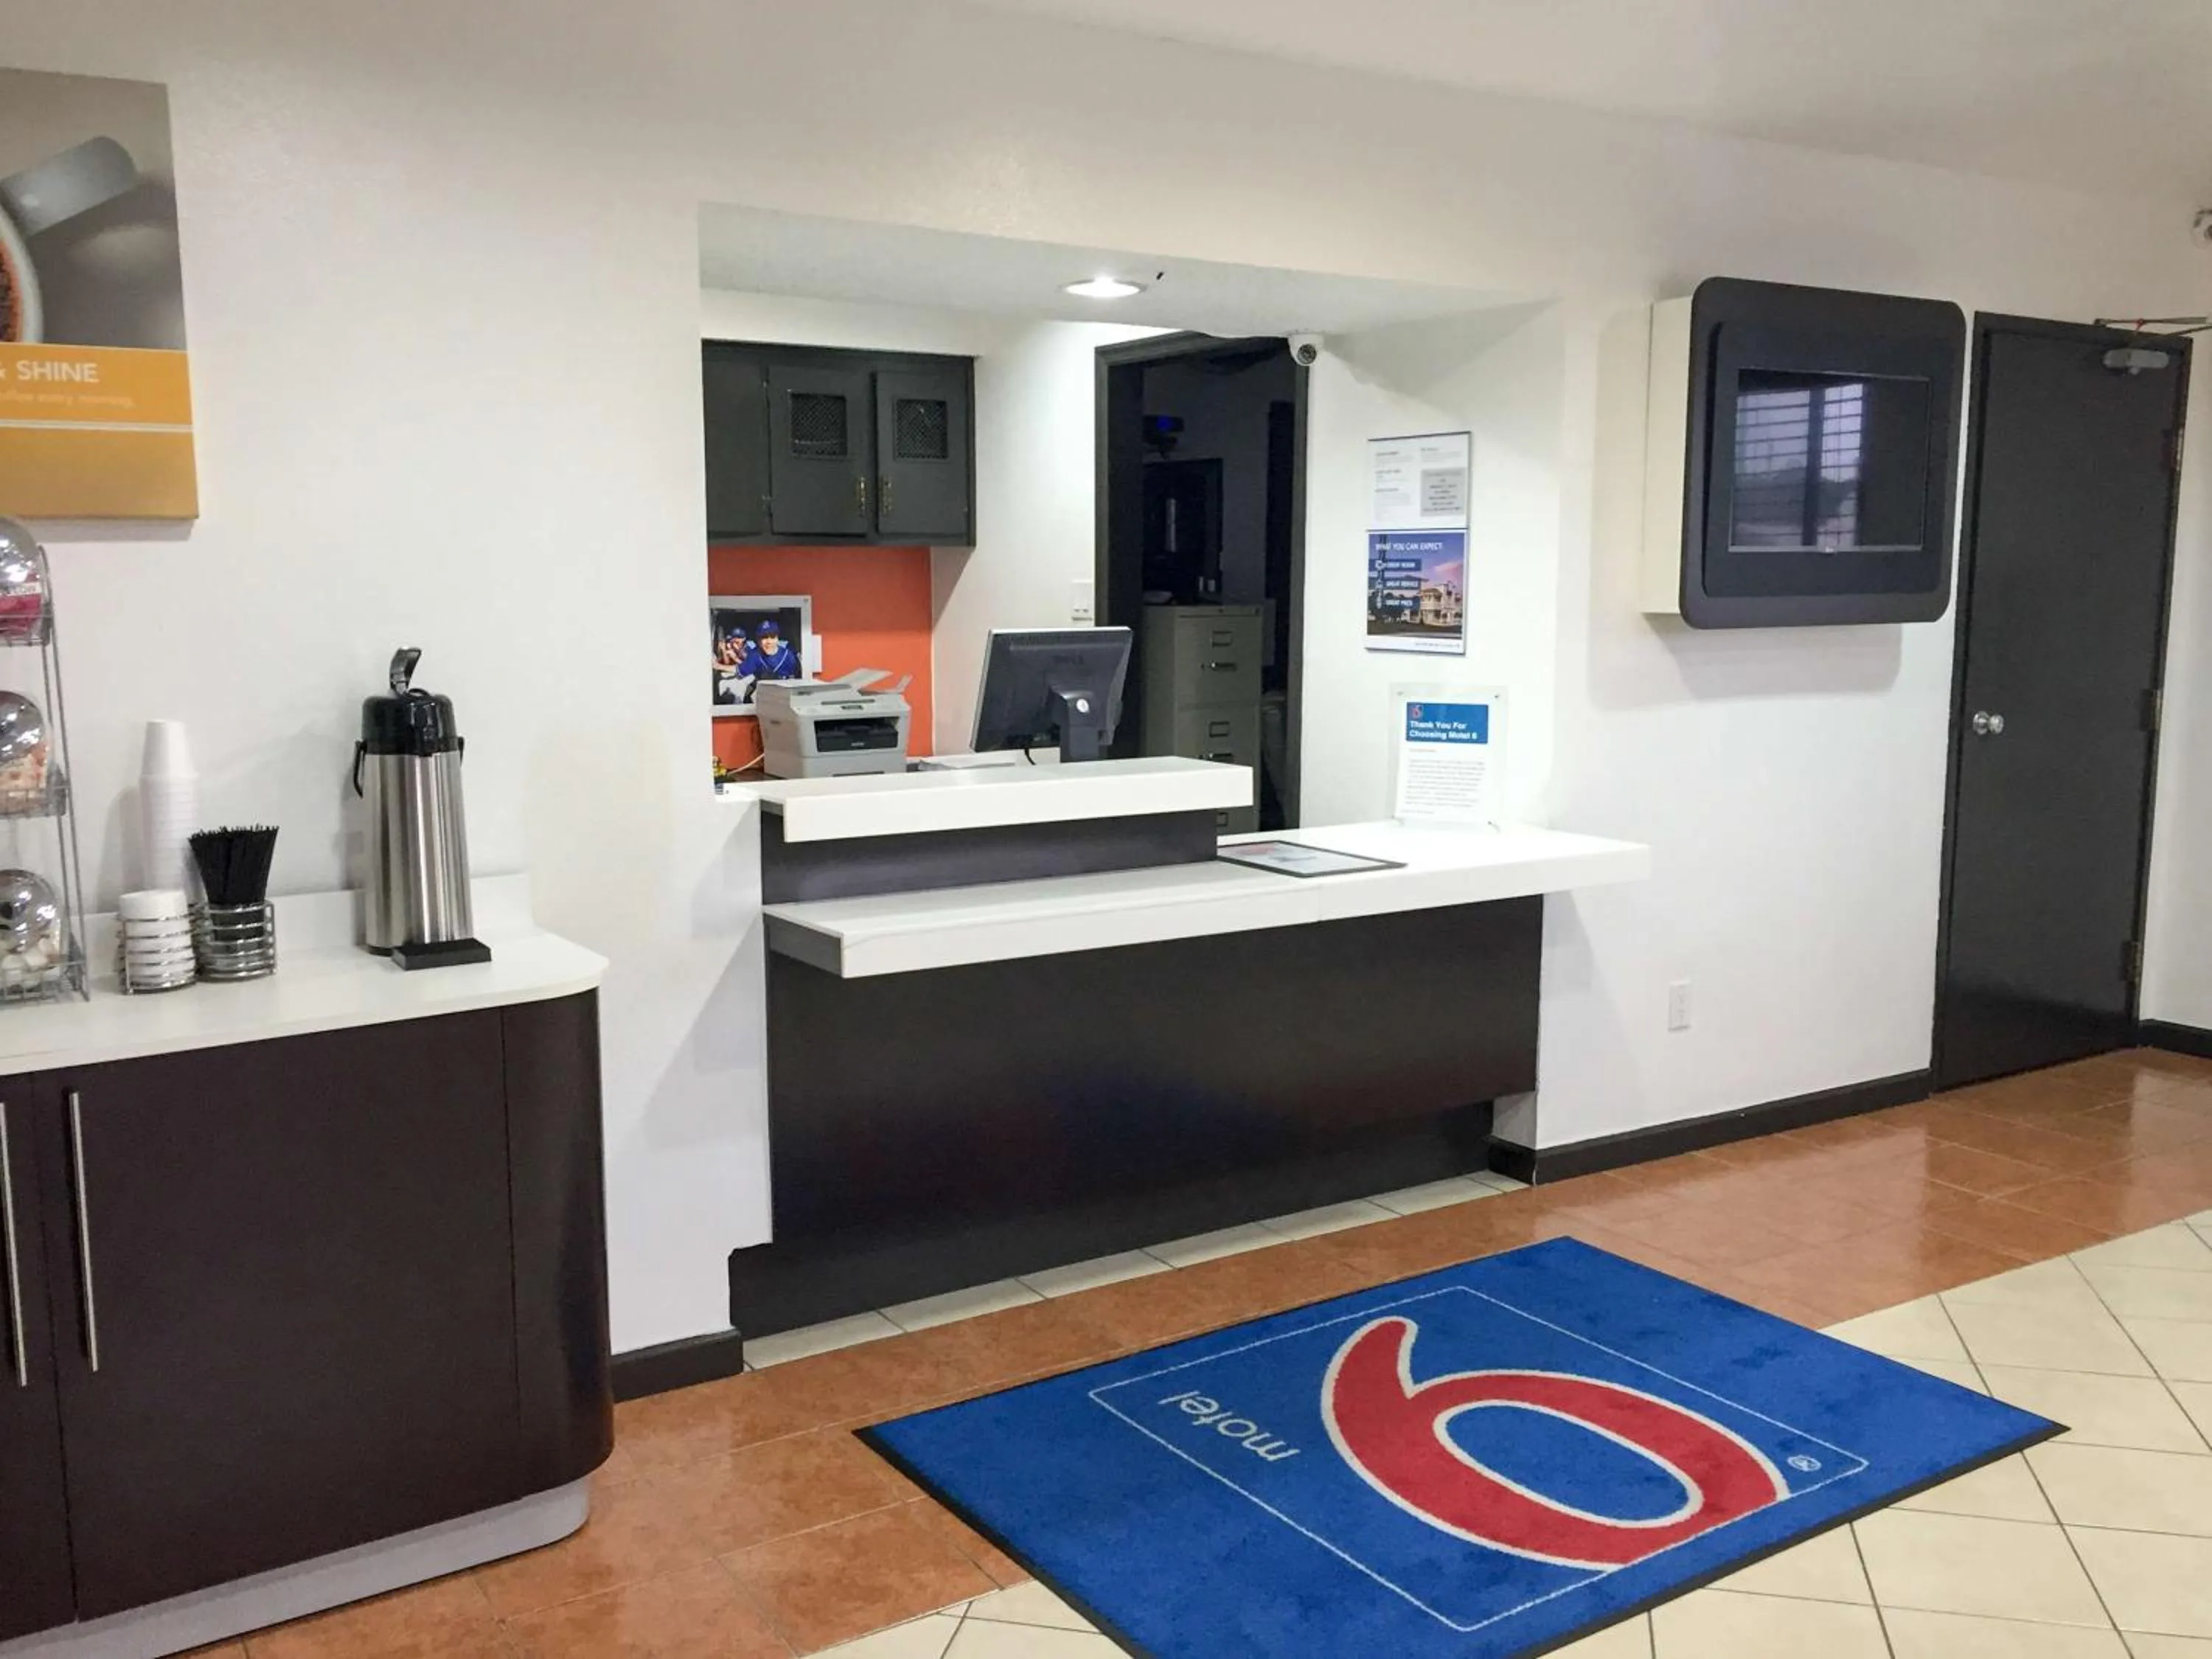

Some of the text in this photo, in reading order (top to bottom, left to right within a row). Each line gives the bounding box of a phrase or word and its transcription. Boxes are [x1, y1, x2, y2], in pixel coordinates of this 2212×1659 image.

[16, 359, 100, 383] SHINE
[1392, 542, 1404, 551] YOU
[1405, 542, 1419, 551] CAN
[1410, 730, 1447, 740] Choosing
[1448, 731, 1470, 740] Motel
[1157, 1390, 1301, 1462] motel
